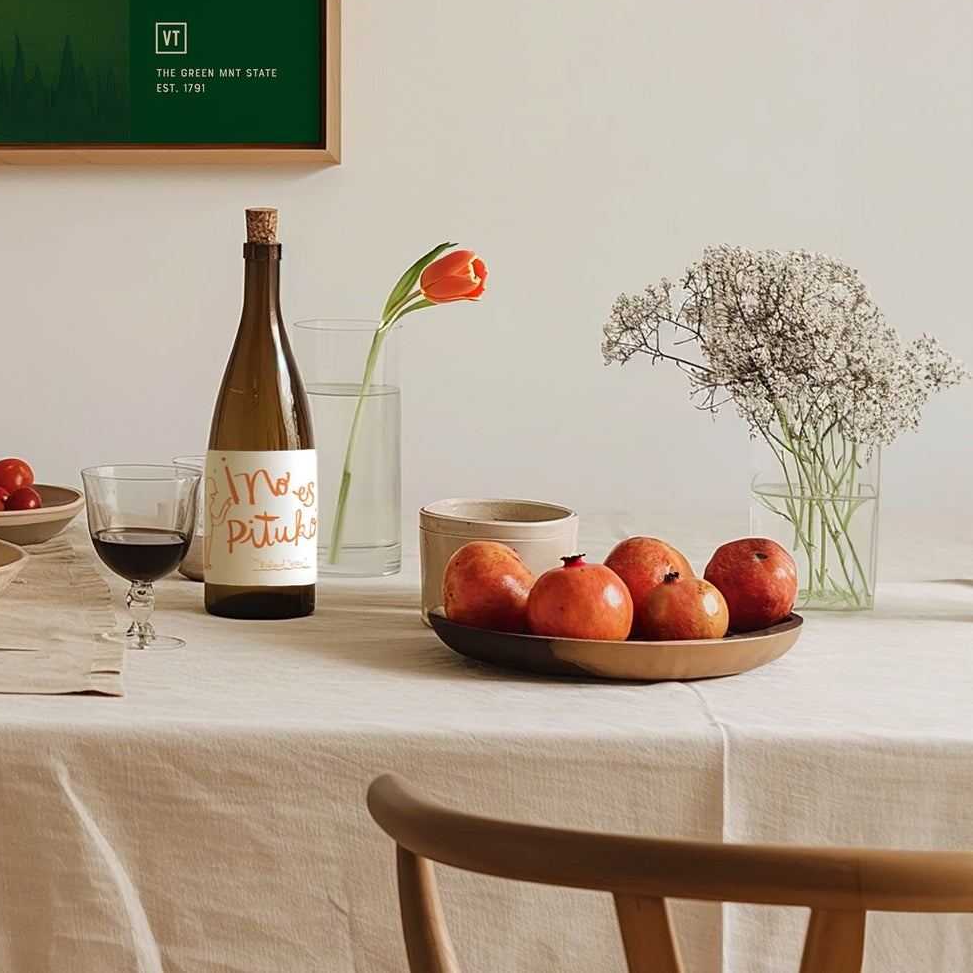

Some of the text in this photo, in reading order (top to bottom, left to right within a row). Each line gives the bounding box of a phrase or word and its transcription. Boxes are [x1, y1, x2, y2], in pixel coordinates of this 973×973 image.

[162, 30, 181, 47] VT
[156, 68, 277, 78] THE GREEN MNT STATE
[156, 83, 206, 93] EST. 1791
